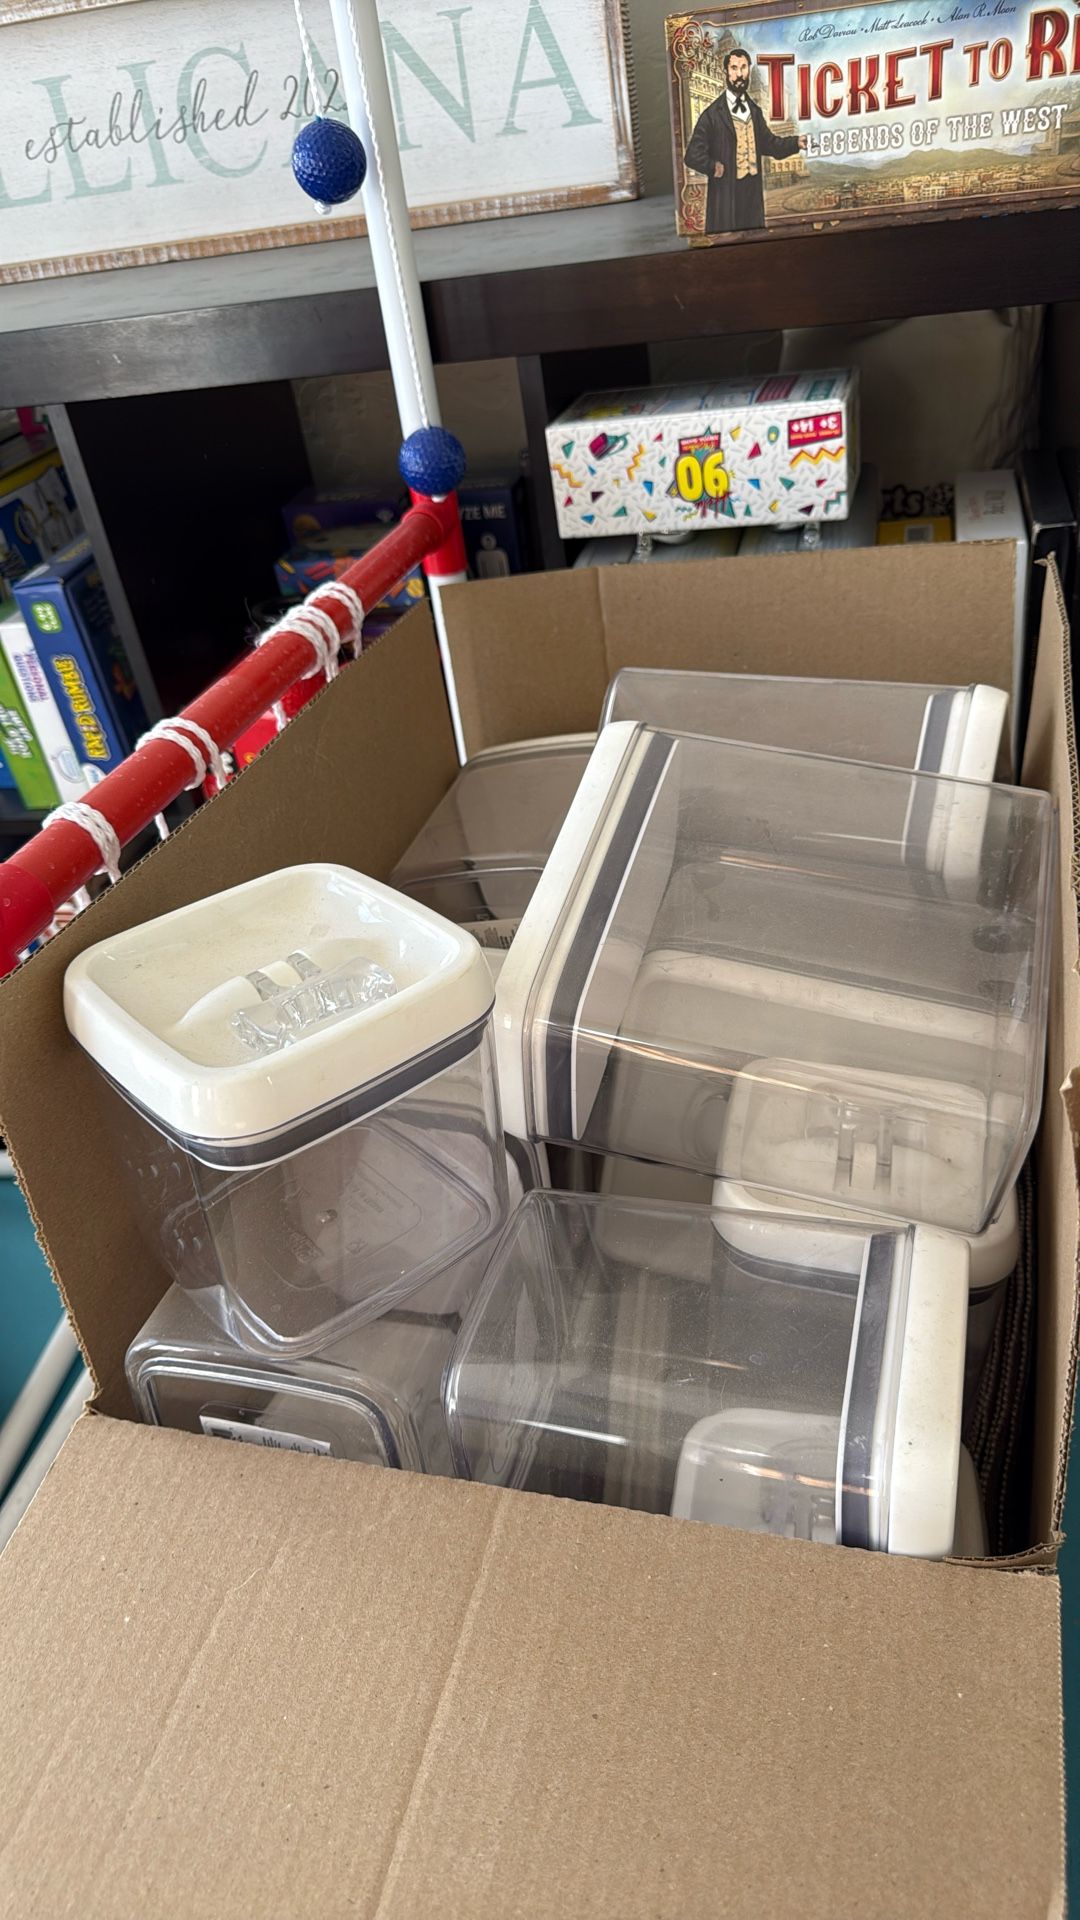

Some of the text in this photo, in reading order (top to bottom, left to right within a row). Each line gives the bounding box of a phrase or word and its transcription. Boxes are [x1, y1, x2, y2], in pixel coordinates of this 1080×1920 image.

[798, 26, 820, 42] Rob
[864, 17, 893, 33] Matt
[893, 11, 928, 29] Leacock
[937, 6, 970, 23] Alan
[991, 0, 1016, 16] Moon
[757, 39, 954, 121] TICKET
[963, 37, 1013, 87] TO
[25, 68, 348, 164] established 202
[806, 104, 1068, 157] LEGENDS OF THE WEST
[51, 656, 94, 713] RUMBLE
